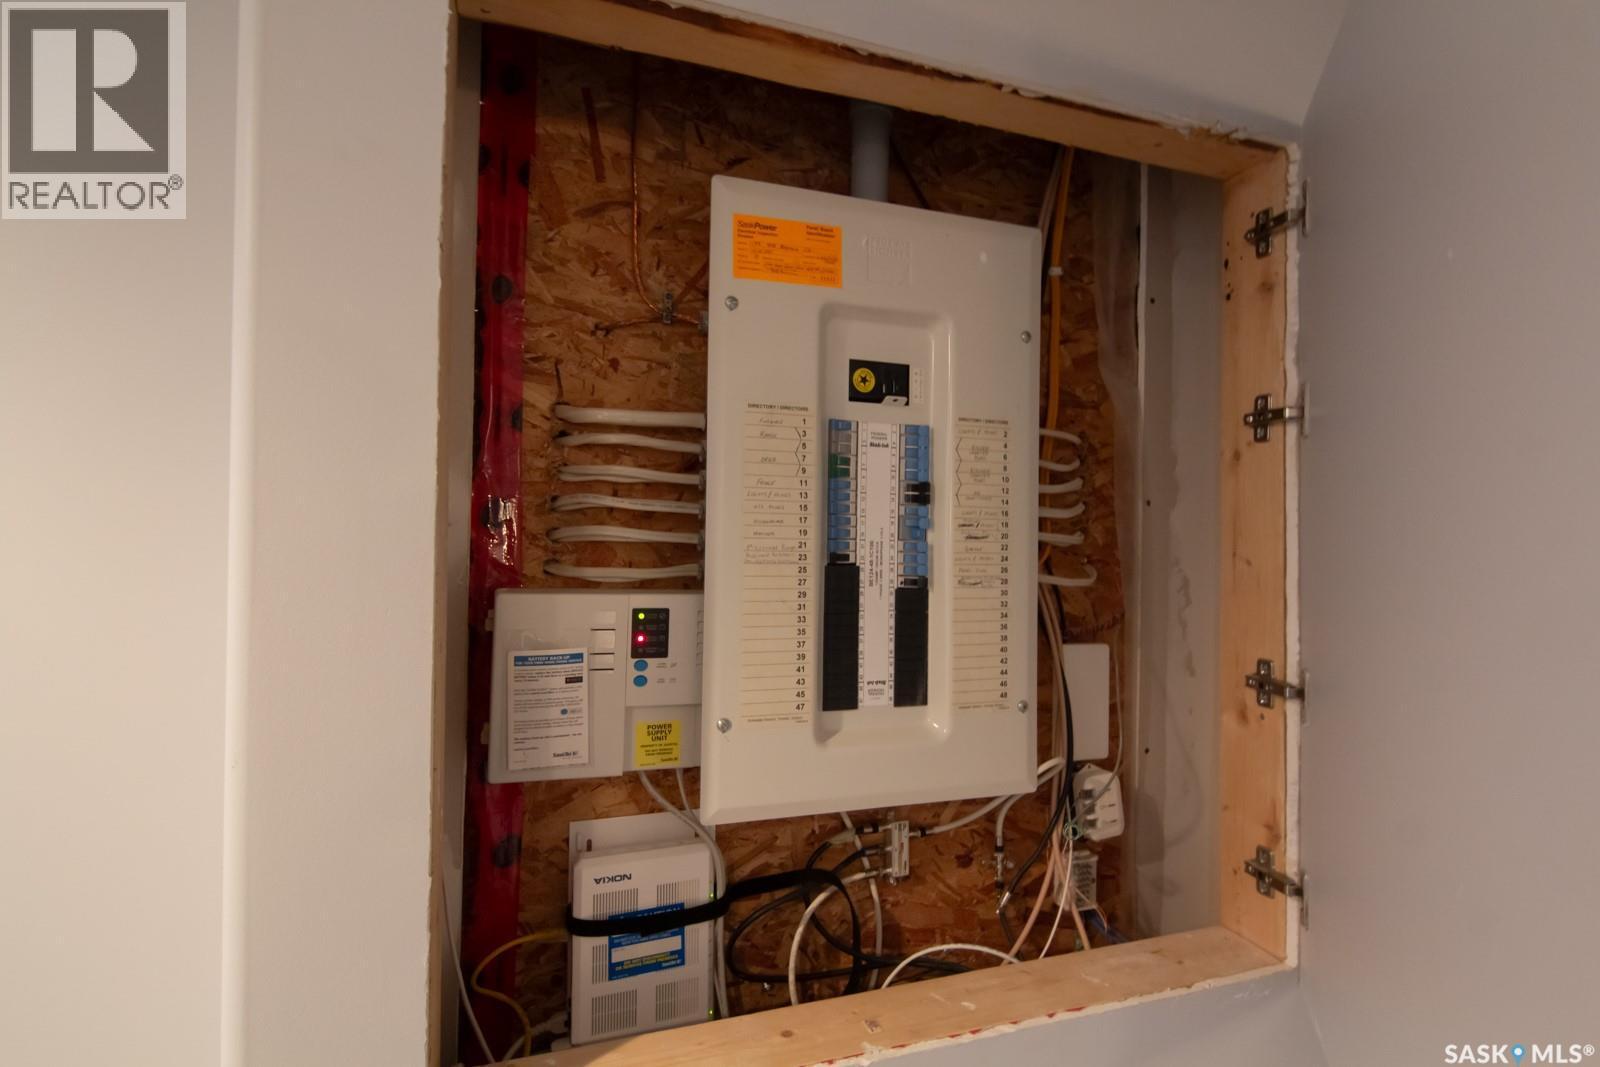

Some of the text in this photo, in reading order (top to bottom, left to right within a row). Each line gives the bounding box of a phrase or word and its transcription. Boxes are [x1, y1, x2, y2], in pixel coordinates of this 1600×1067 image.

[800, 492, 808, 500] 13
[800, 504, 808, 512] 15
[798, 528, 808, 536] 19
[798, 554, 808, 562] 23
[798, 566, 808, 574] 25
[798, 578, 806, 586] 27
[798, 590, 806, 598] 29
[796, 616, 806, 624] 33
[796, 628, 806, 636] 35
[796, 640, 806, 648] 37
[796, 652, 806, 660] 39
[796, 678, 806, 686] 43
[796, 690, 806, 698] 45
[796, 702, 806, 710] 47
[593, 873, 632, 885] NOKIA
